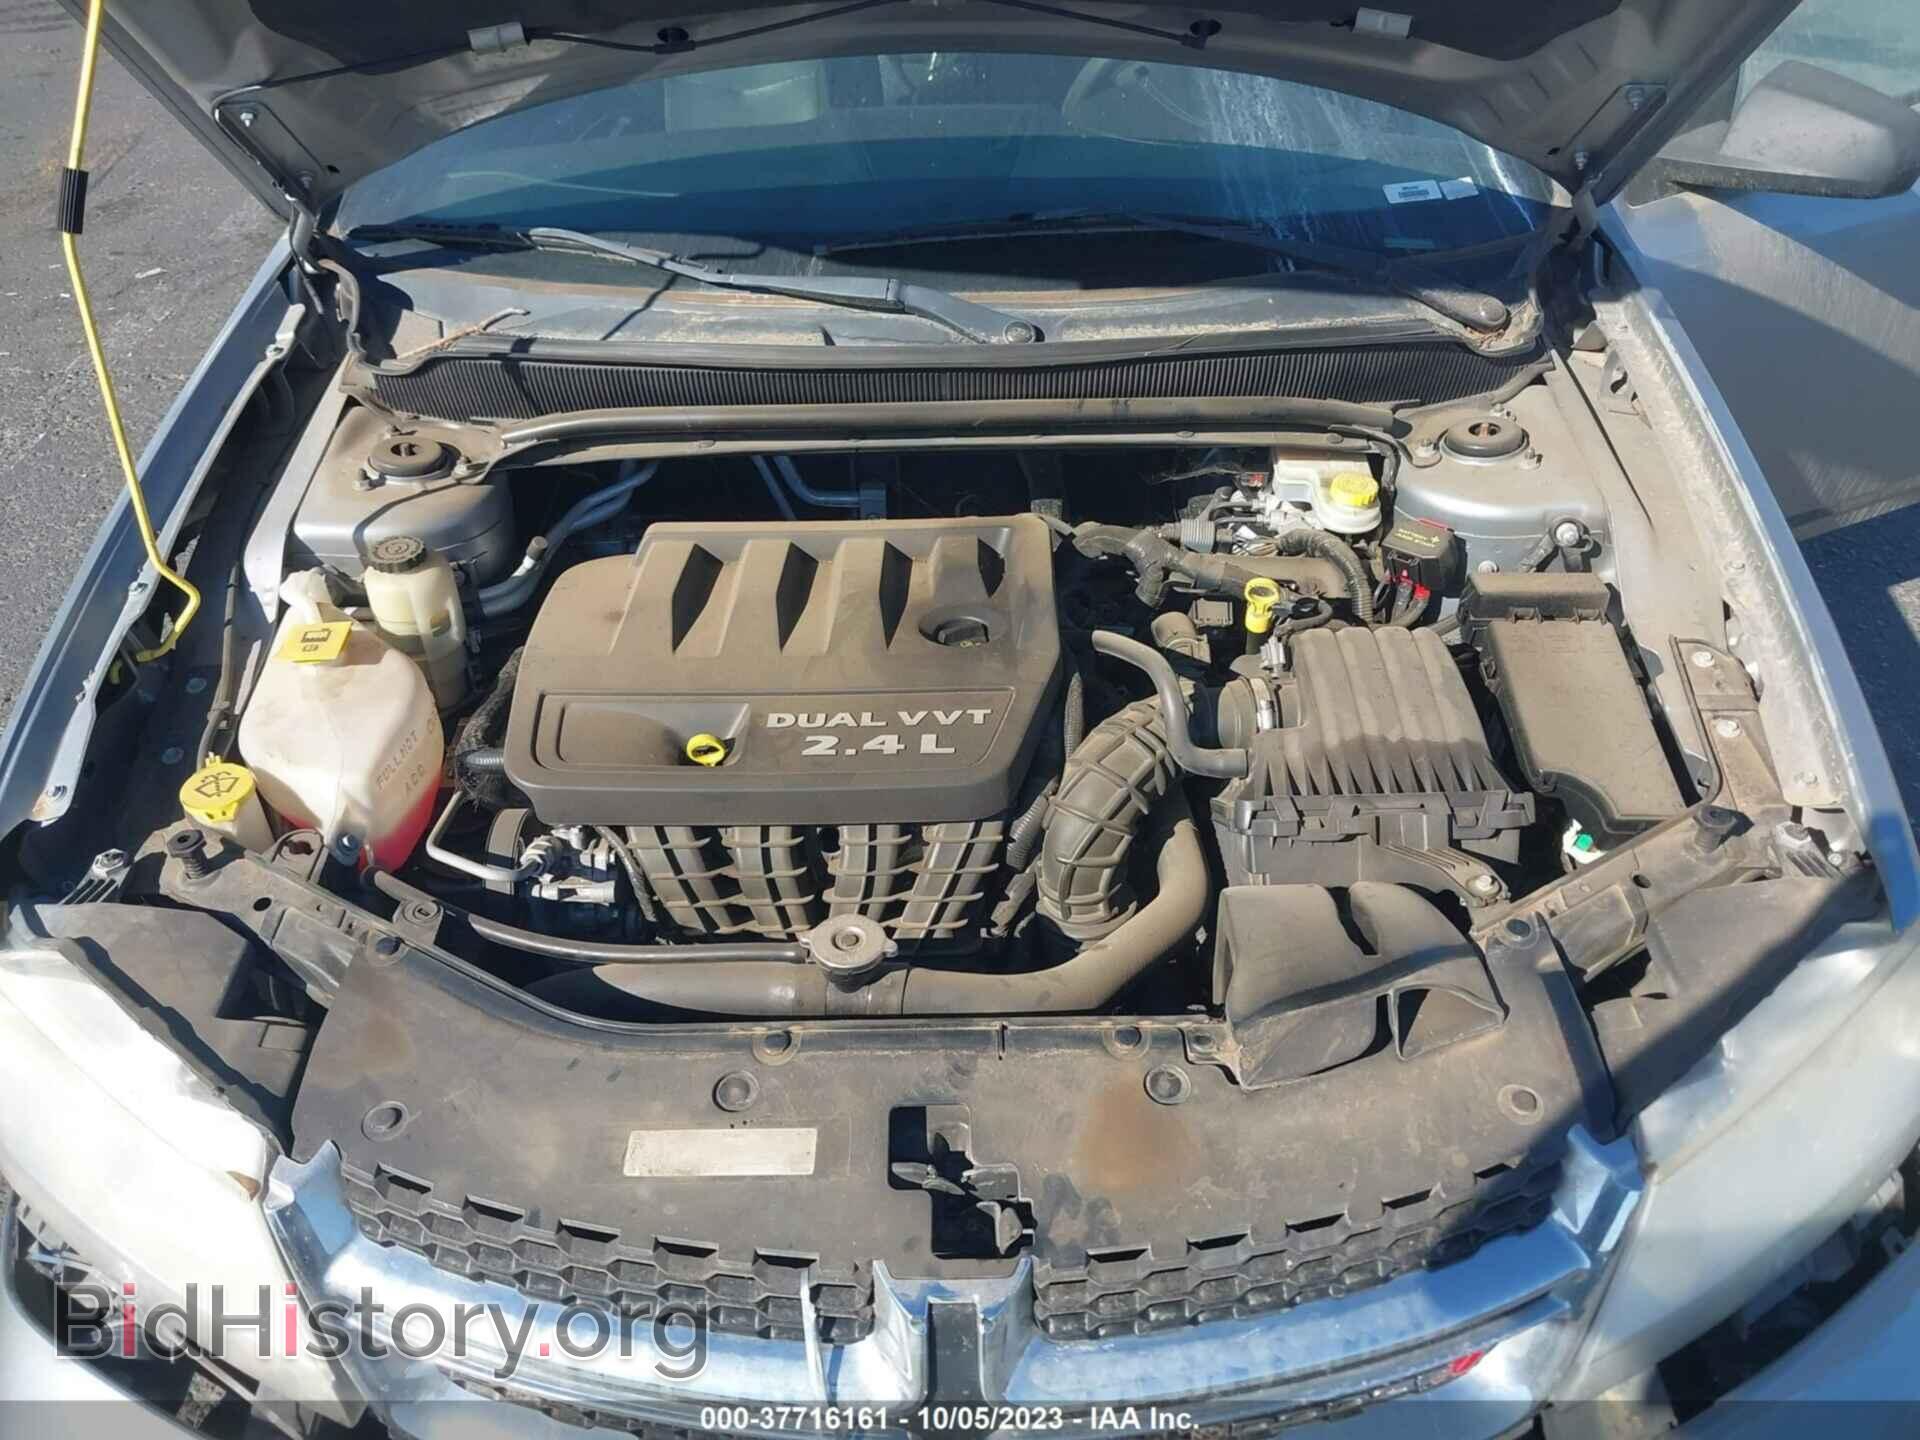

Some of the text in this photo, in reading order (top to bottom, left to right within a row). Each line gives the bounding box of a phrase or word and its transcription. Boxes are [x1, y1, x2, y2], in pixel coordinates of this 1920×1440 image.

[766, 709, 992, 728] DUAL VVT
[801, 733, 957, 756] 2.4 L
